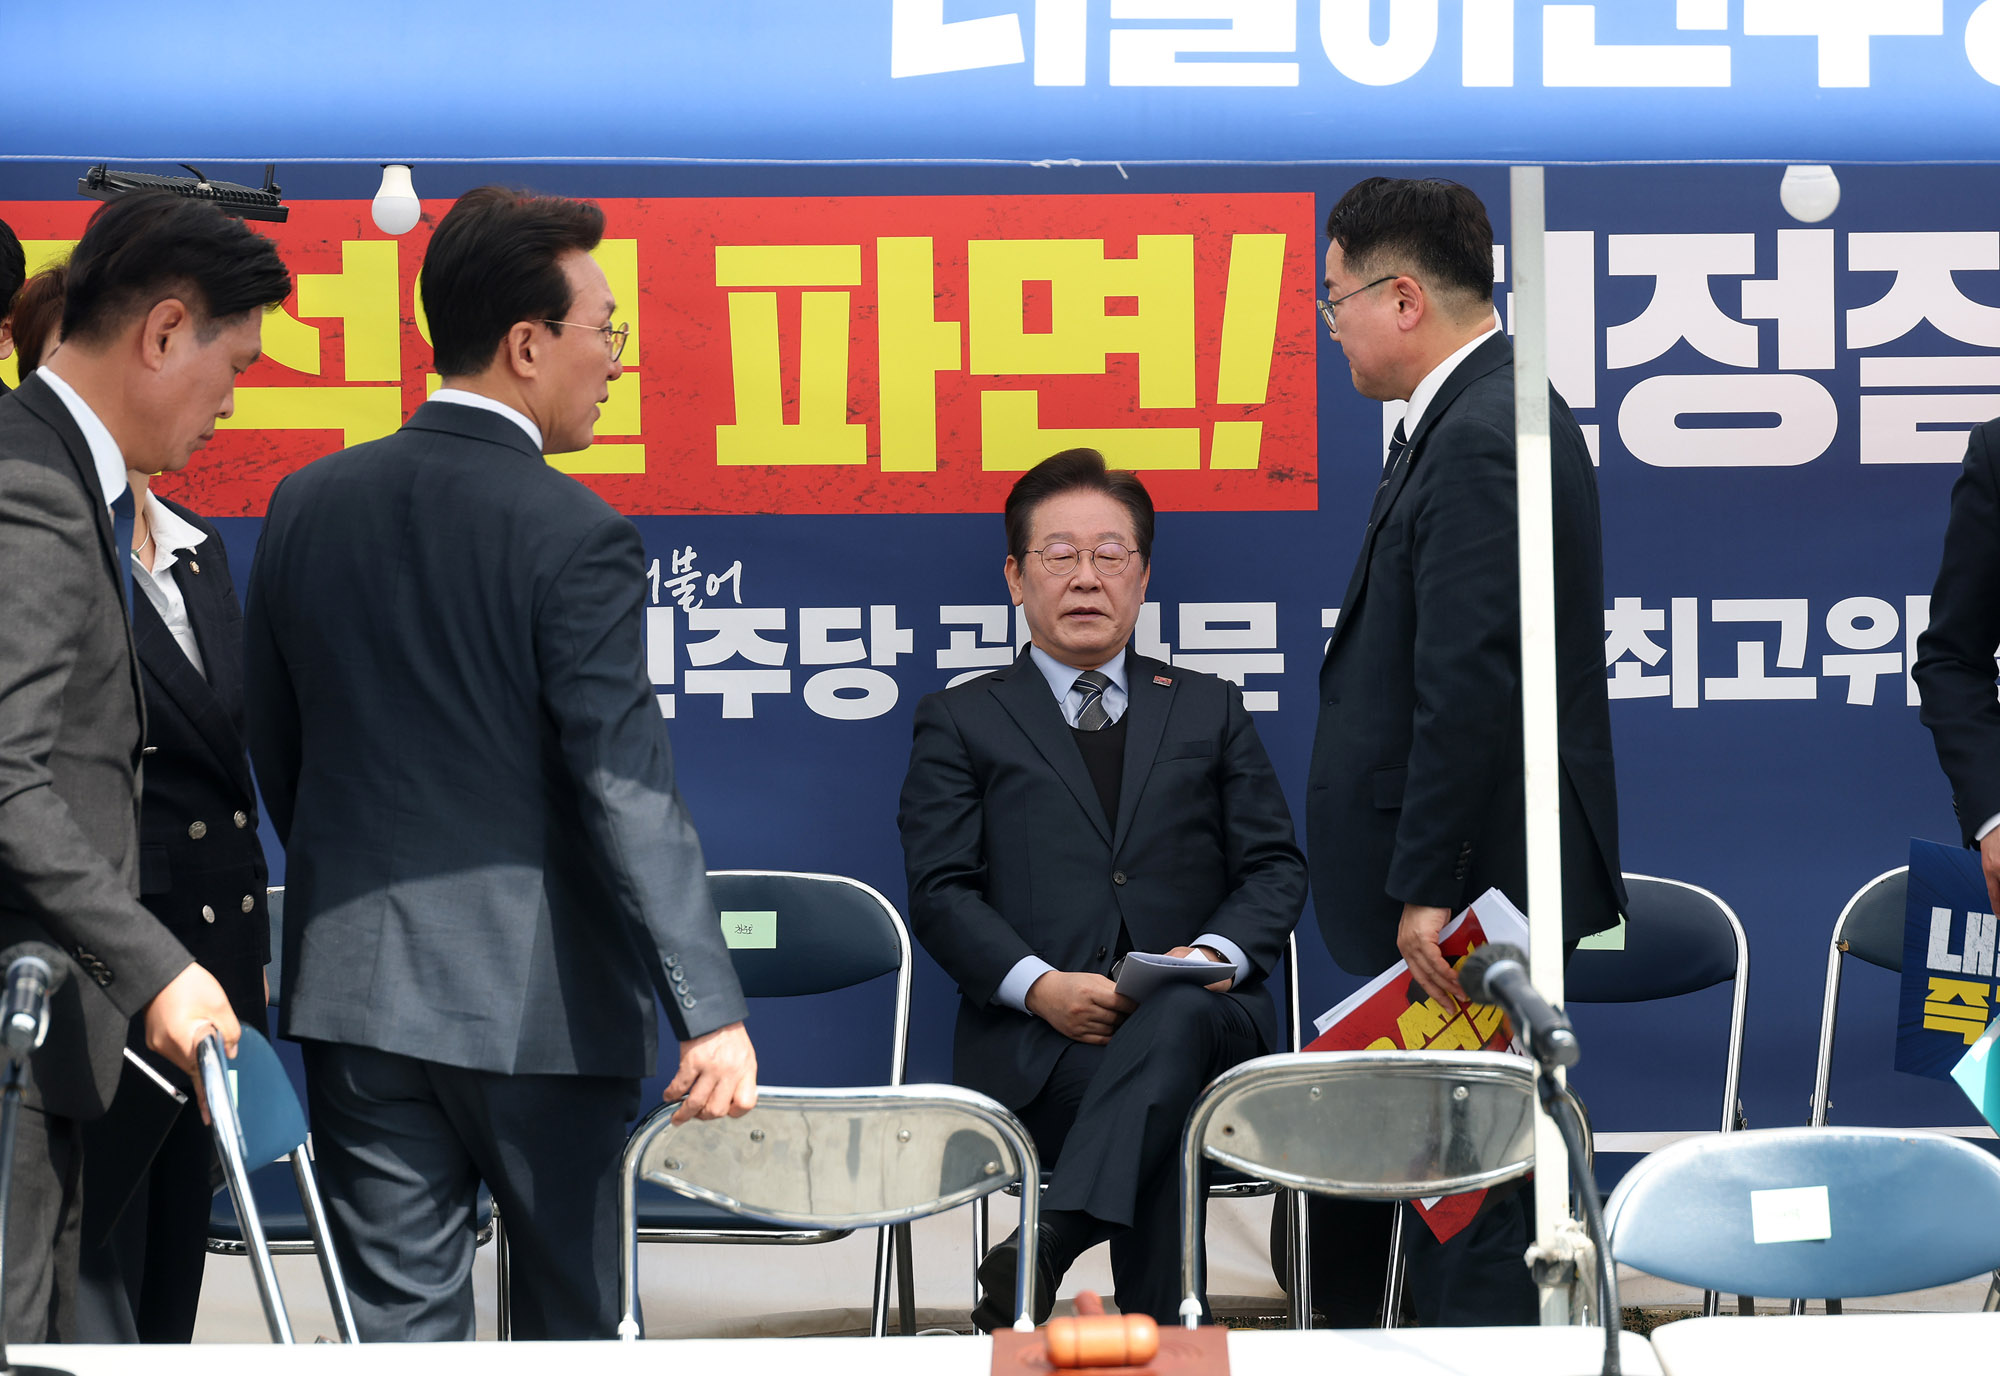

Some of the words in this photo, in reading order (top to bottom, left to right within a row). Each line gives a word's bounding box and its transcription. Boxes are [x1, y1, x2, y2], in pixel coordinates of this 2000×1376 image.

[715, 233, 1287, 473] 파면!
[936, 601, 1285, 712] 광문
[1603, 595, 2000, 709] 최고위
[1926, 906, 2000, 978] 내
